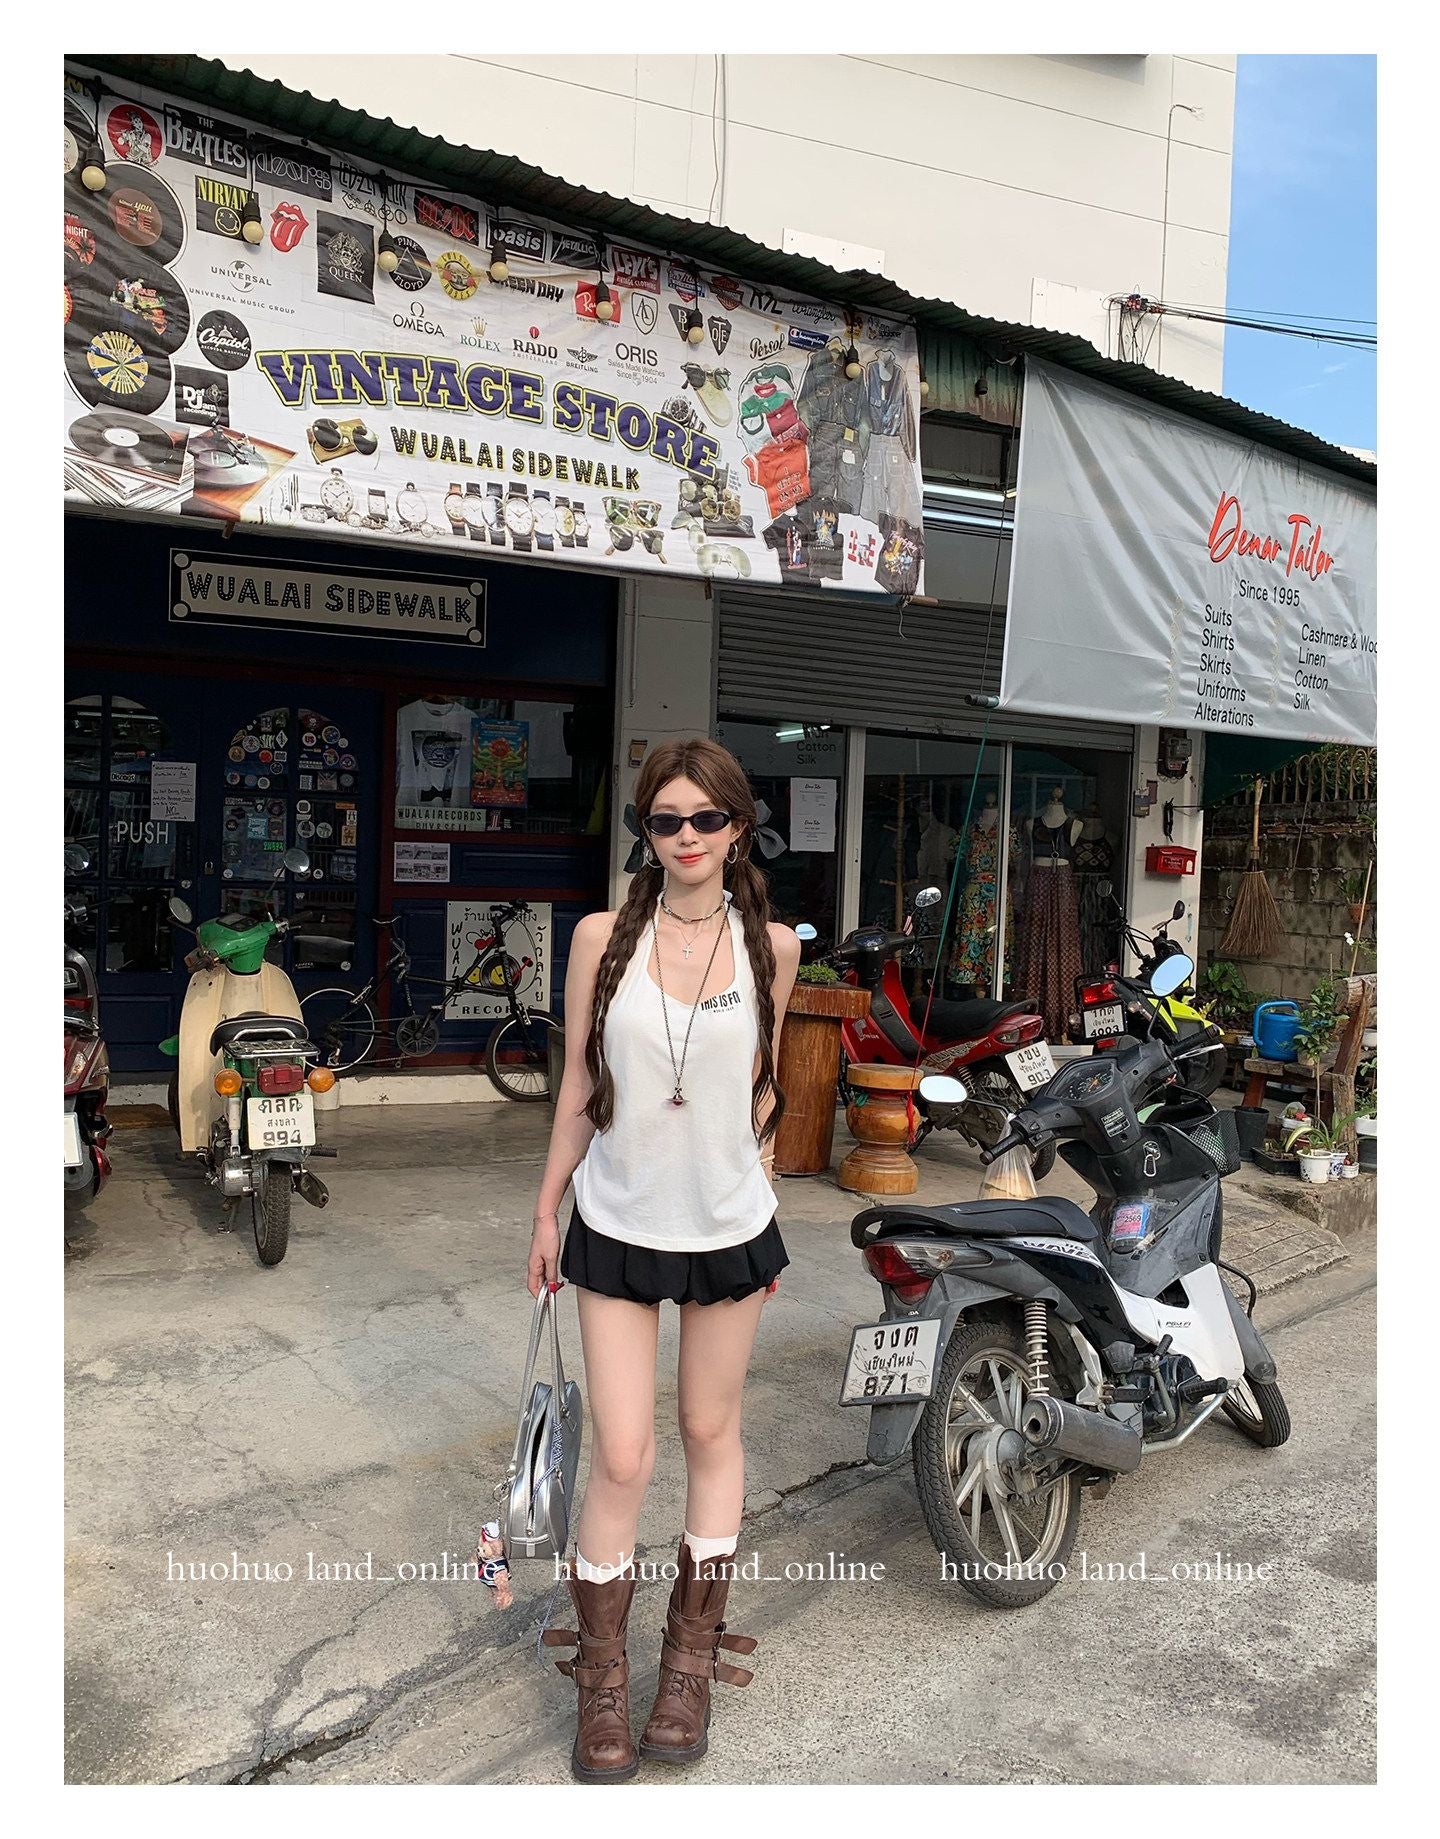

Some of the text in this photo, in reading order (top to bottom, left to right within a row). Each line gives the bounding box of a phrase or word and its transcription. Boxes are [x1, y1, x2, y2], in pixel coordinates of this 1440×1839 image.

[164, 106, 246, 169] BEATLES
[198, 176, 255, 211] NIRVAN
[66, 224, 89, 239] NIGHT
[493, 229, 542, 252] oasis
[398, 237, 418, 251] PINK
[210, 266, 273, 287] UNIVERSAL
[328, 265, 364, 284] QUEEN
[394, 274, 424, 291] FLOYD
[189, 288, 297, 315] UNIVERSAL MUSIC GROUP
[536, 280, 565, 302] DAY
[392, 313, 445, 338] OMEGA
[198, 327, 249, 350] Capitol
[460, 334, 501, 352] ROLEX
[512, 338, 558, 360] RADO
[750, 333, 785, 360] Persol
[615, 342, 658, 367] ORIS
[565, 360, 599, 373] BREITLING
[607, 358, 666, 378] Swiss Made Watches
[616, 369, 658, 385] Since 1904
[255, 349, 721, 481] VINTAGE STORE
[389, 426, 641, 492] WUALAI SIDEWALK
[1286, 513, 1335, 582] Tailor
[186, 571, 473, 624] WUALAI SIDEWALK
[1238, 579, 1301, 607] Since 1995
[1204, 604, 1233, 627] Suits
[1201, 628, 1236, 652] Shirts
[1301, 623, 1349, 649] Cashmere
[1350, 634, 1358, 650] &
[1199, 653, 1232, 676] Skirts
[1298, 646, 1327, 668] Linen
[1196, 677, 1247, 702] Uniforms
[1294, 670, 1330, 691] Cotton
[1293, 692, 1311, 711] Silk
[1194, 702, 1255, 727] Alterations
[796, 741, 837, 752] Cotton
[796, 753, 818, 765] Silk
[117, 820, 170, 845] PUSH
[1090, 1024, 1120, 1038] 4003
[1027, 1068, 1052, 1085] 903
[267, 1117, 296, 1127] สงขลา
[263, 1129, 302, 1147] 994
[867, 1350, 915, 1371] เชียงใหม่
[863, 1371, 909, 1397] 871
